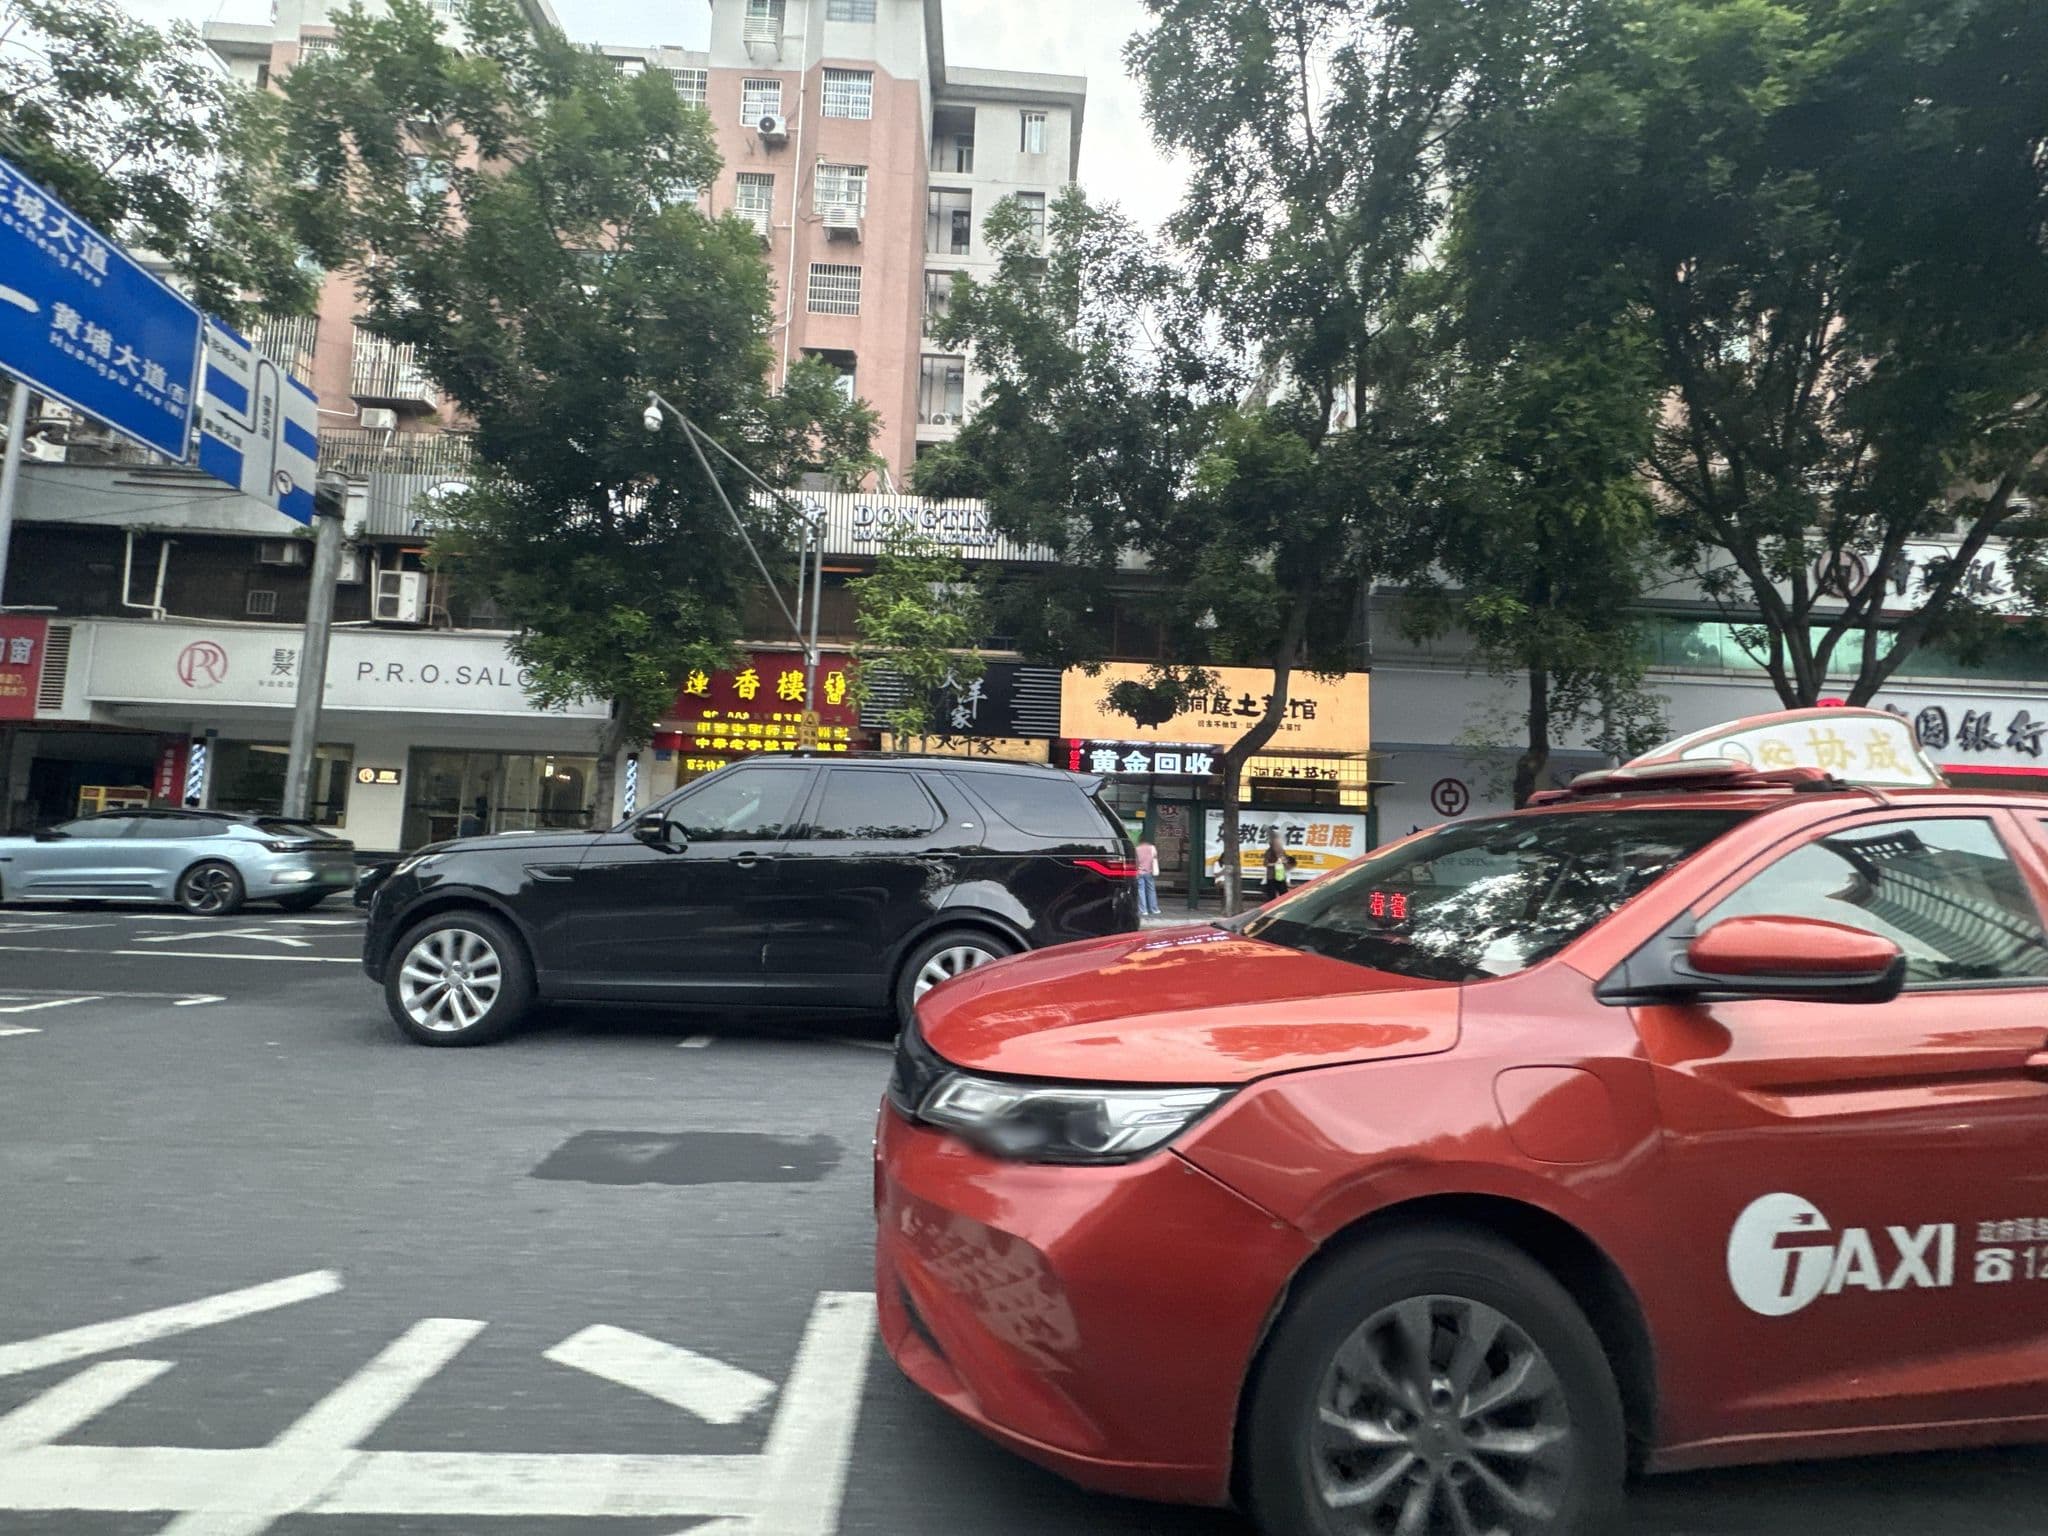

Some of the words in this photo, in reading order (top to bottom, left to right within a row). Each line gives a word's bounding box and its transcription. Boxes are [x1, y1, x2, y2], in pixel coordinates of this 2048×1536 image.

[0, 211, 69, 268] acheng
[50, 331, 128, 386] Huangpu
[855, 505, 992, 532] DONGTIN
[357, 662, 535, 687] P.R.O.SALO
[1089, 749, 1214, 775] 黄金回收
[1755, 1212, 1956, 1302] TAXI
